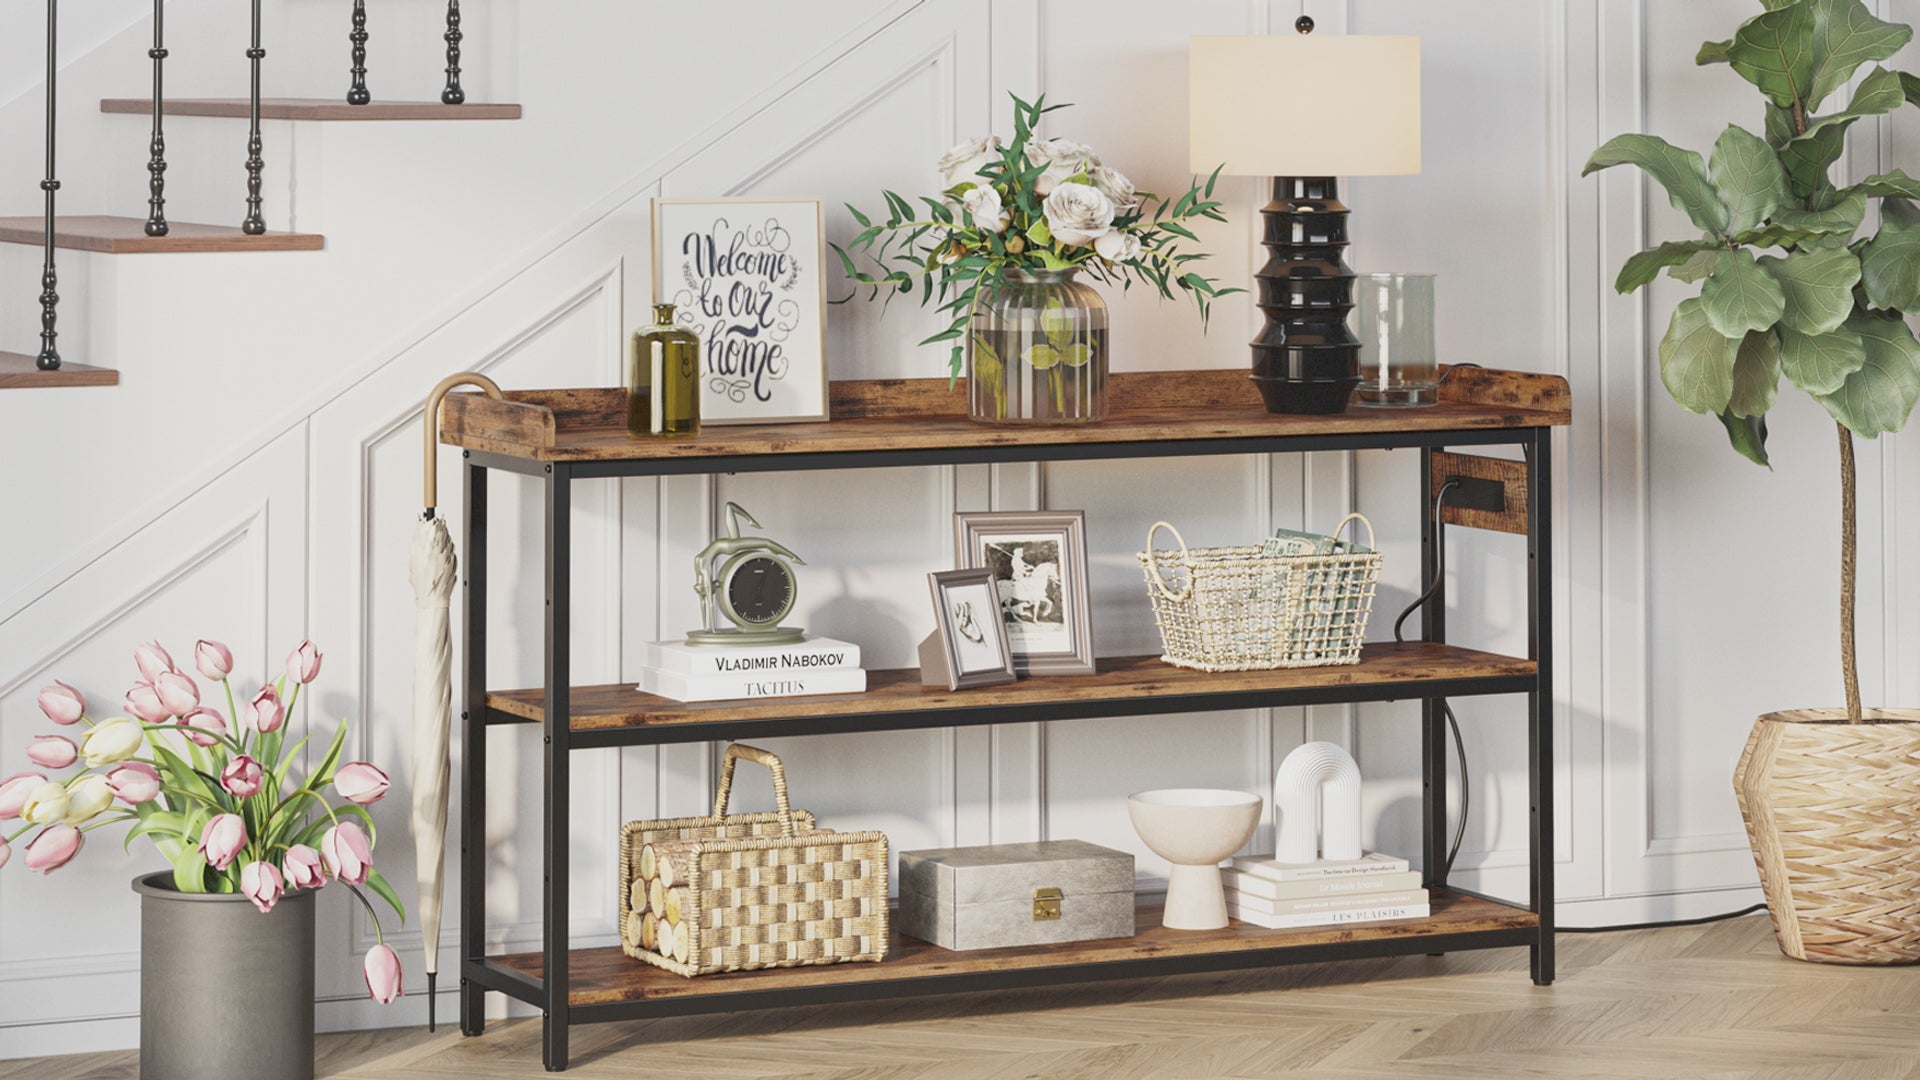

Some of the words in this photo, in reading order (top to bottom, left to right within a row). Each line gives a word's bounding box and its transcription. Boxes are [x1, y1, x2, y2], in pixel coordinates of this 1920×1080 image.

[683, 218, 789, 283] Welcome
[697, 277, 723, 318] to
[705, 319, 783, 402] home
[744, 680, 805, 696] TACITUS
[1333, 912, 1352, 922] LES
[1356, 908, 1406, 920] PLAISIRS
